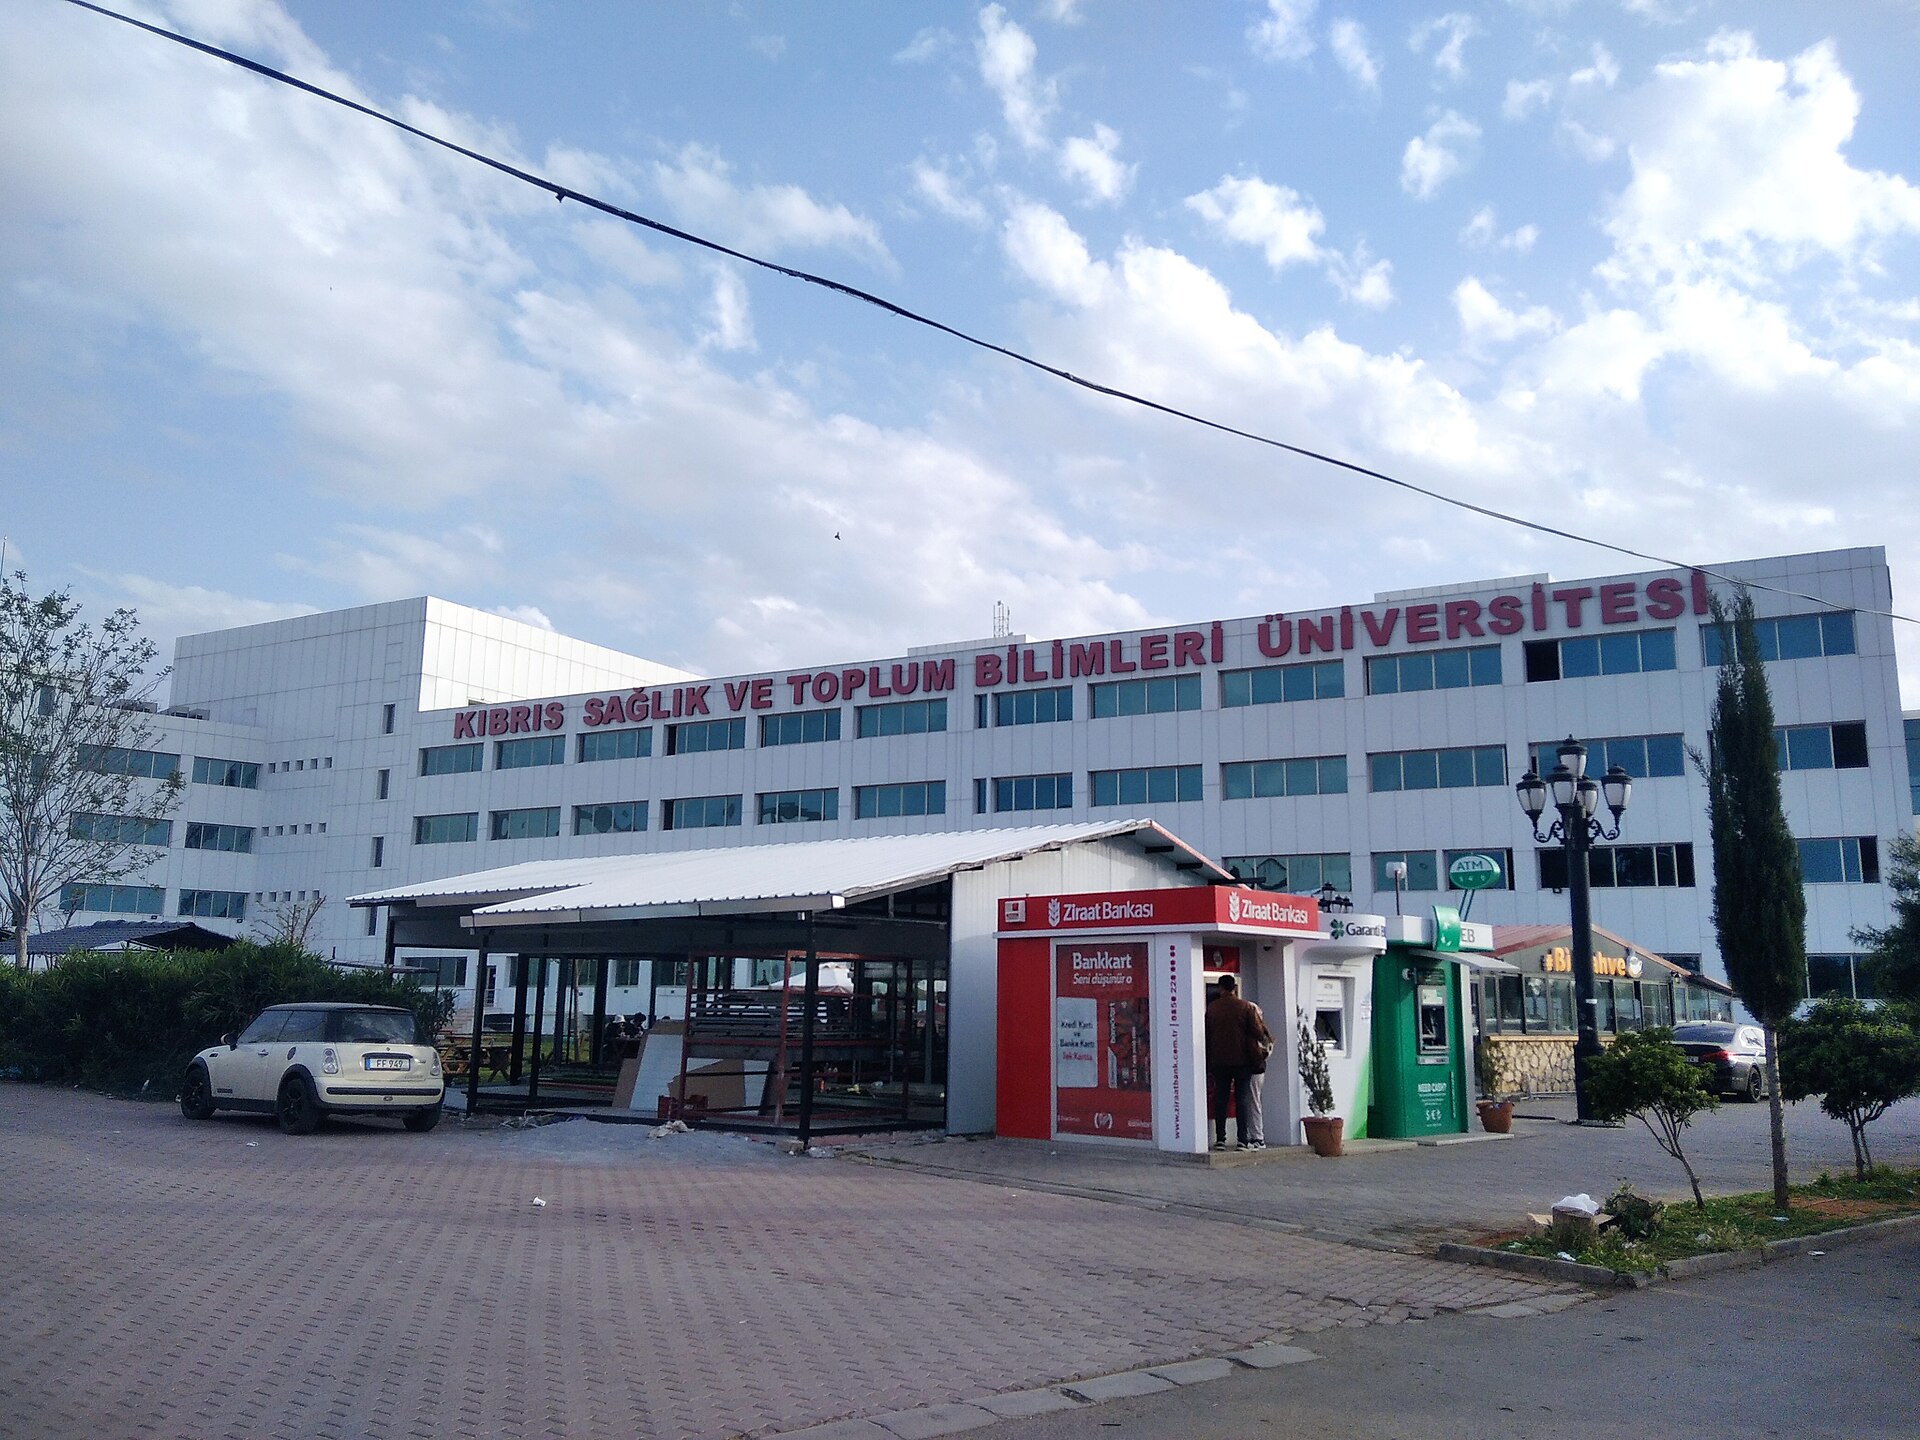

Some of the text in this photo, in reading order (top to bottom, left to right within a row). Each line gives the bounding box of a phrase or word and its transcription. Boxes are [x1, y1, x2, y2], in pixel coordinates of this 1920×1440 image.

[453, 568, 1709, 739] KIBRIS SAĞLIK VE TOPLUM BİLİMLERİ ÜNİVERSİTESİ
[1457, 860, 1483, 871] ATM
[1063, 900, 1154, 921] Ziraat Bankası
[1241, 899, 1309, 924] Ziraat Bankası
[1460, 927, 1476, 943] EB
[1072, 951, 1133, 970] Bankkart
[1072, 972, 1091, 985] Seni
